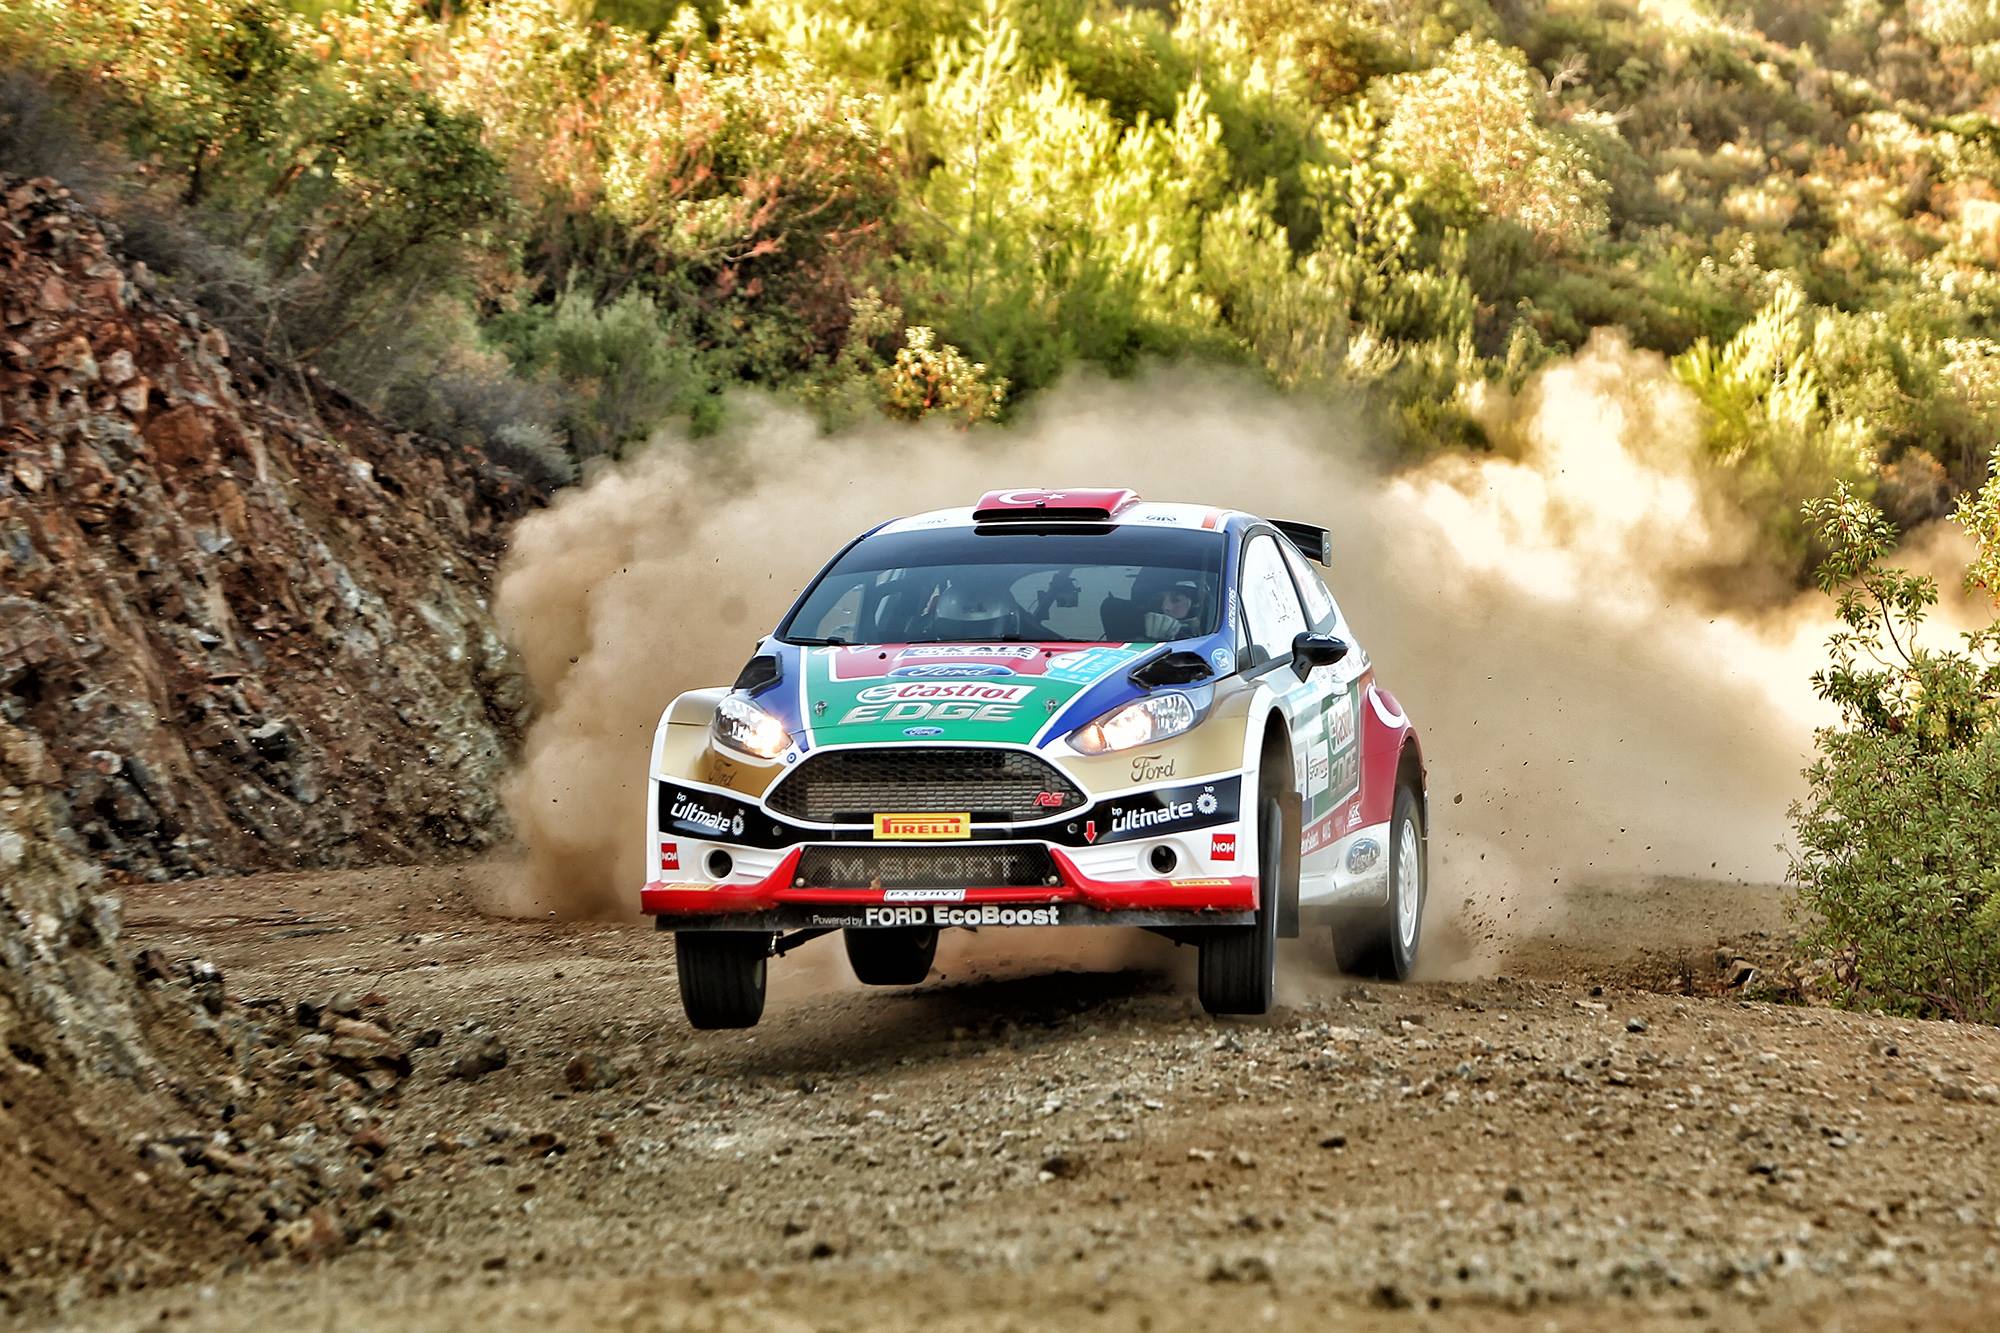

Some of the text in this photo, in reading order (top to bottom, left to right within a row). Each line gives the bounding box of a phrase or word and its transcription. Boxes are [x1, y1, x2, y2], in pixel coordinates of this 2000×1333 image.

[908, 665, 992, 677] Ford
[897, 683, 1020, 700] Castrol
[839, 702, 1025, 725] EDGE
[1131, 754, 1176, 783] Ford
[676, 791, 688, 802] bp
[1033, 792, 1065, 807] RS
[670, 802, 732, 832] ultimate
[1111, 807, 1123, 817] bp
[1112, 801, 1194, 832] ultimate
[882, 817, 961, 834] PIRELLI
[812, 904, 1060, 927] Powered by FORD EcoBoost
